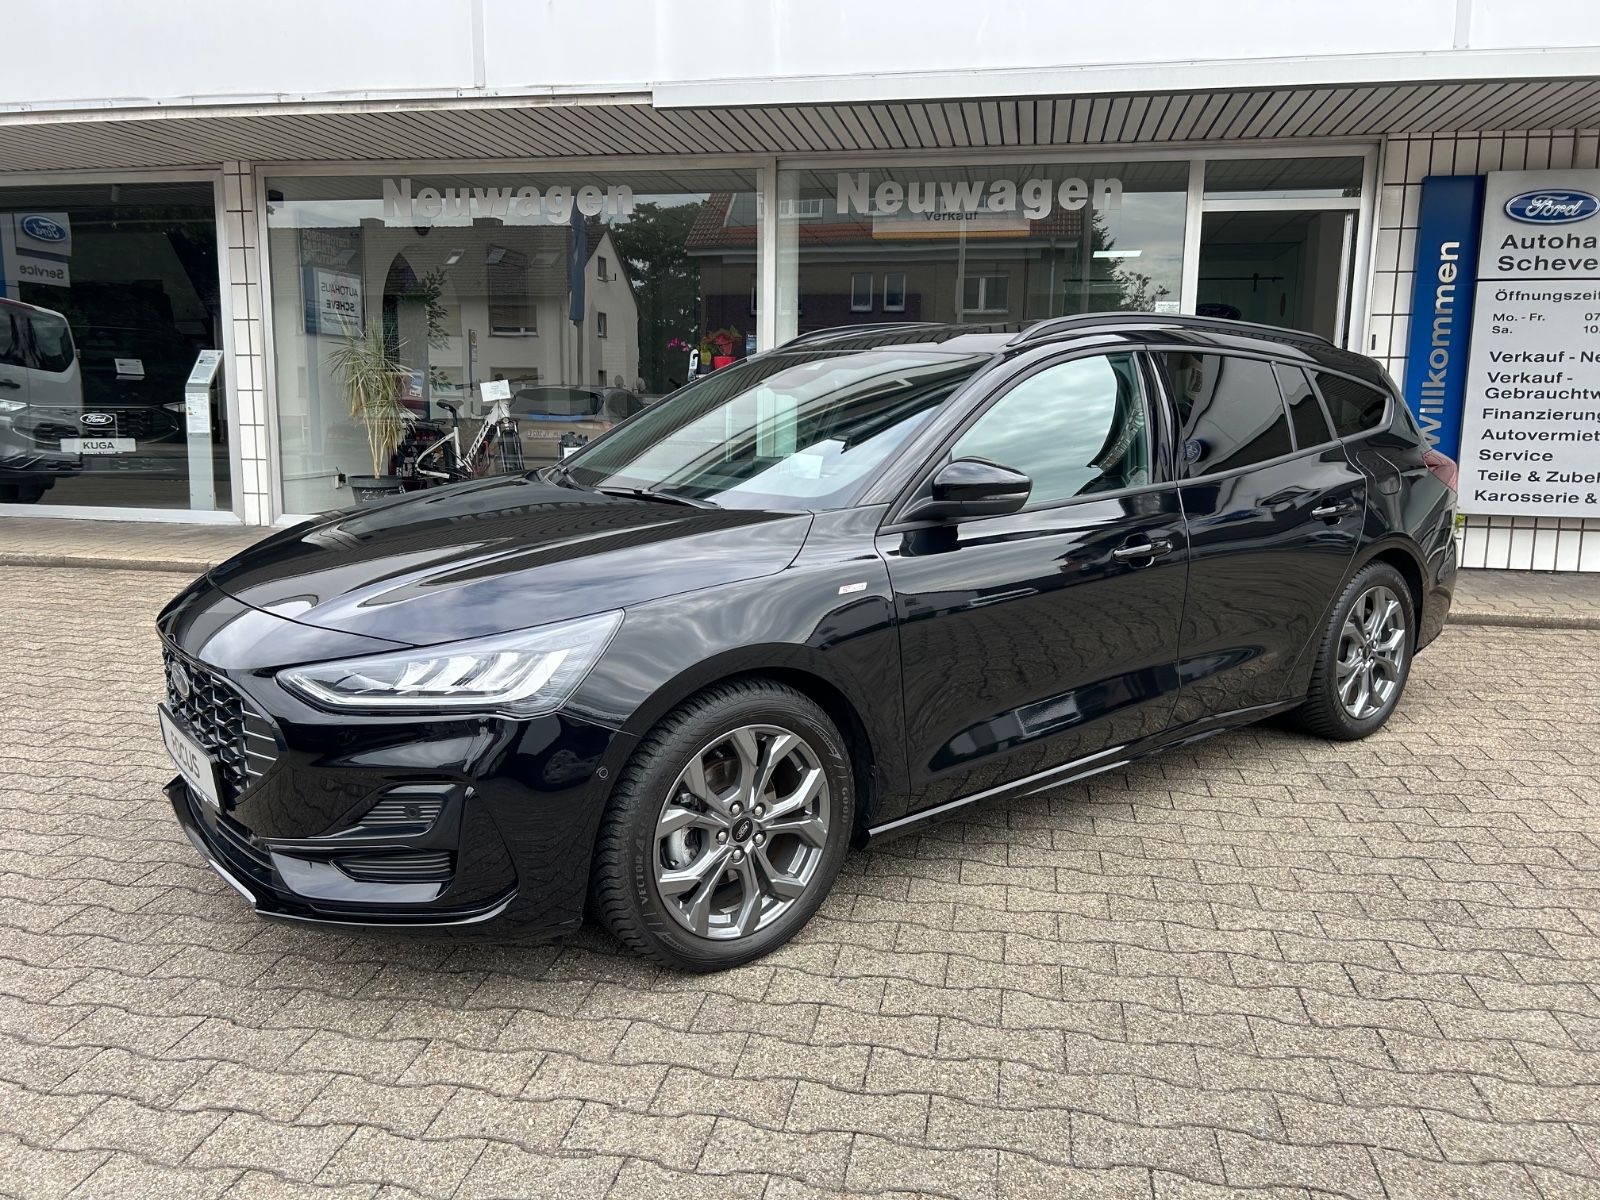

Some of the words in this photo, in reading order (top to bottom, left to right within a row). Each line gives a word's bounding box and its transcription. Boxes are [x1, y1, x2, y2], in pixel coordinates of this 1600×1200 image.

[383, 178, 633, 224] Neuwagen
[837, 172, 1123, 220] Neuwagen
[1525, 195, 1583, 217] Ford
[1500, 233, 1597, 249] Autoha
[1498, 255, 1598, 271] Scheve
[1495, 289, 1600, 303] Öffnungszei
[1492, 313, 1518, 321] Mo.
[1529, 313, 1545, 321] Fr.
[1491, 325, 1513, 334] Sa.
[1419, 241, 1460, 447] Willkommen
[1489, 351, 1565, 362] Verkauf
[1487, 371, 1563, 383] Verkauf
[1481, 429, 1600, 441] Autovermiet
[83, 441, 115, 449] KUGA
[1479, 449, 1553, 461] Service
[1477, 469, 1521, 481] Teile
[1527, 471, 1540, 482] &
[1474, 490, 1579, 503] Karosserie
[1585, 493, 1597, 504] &
[170, 729, 200, 779] FOCUS
